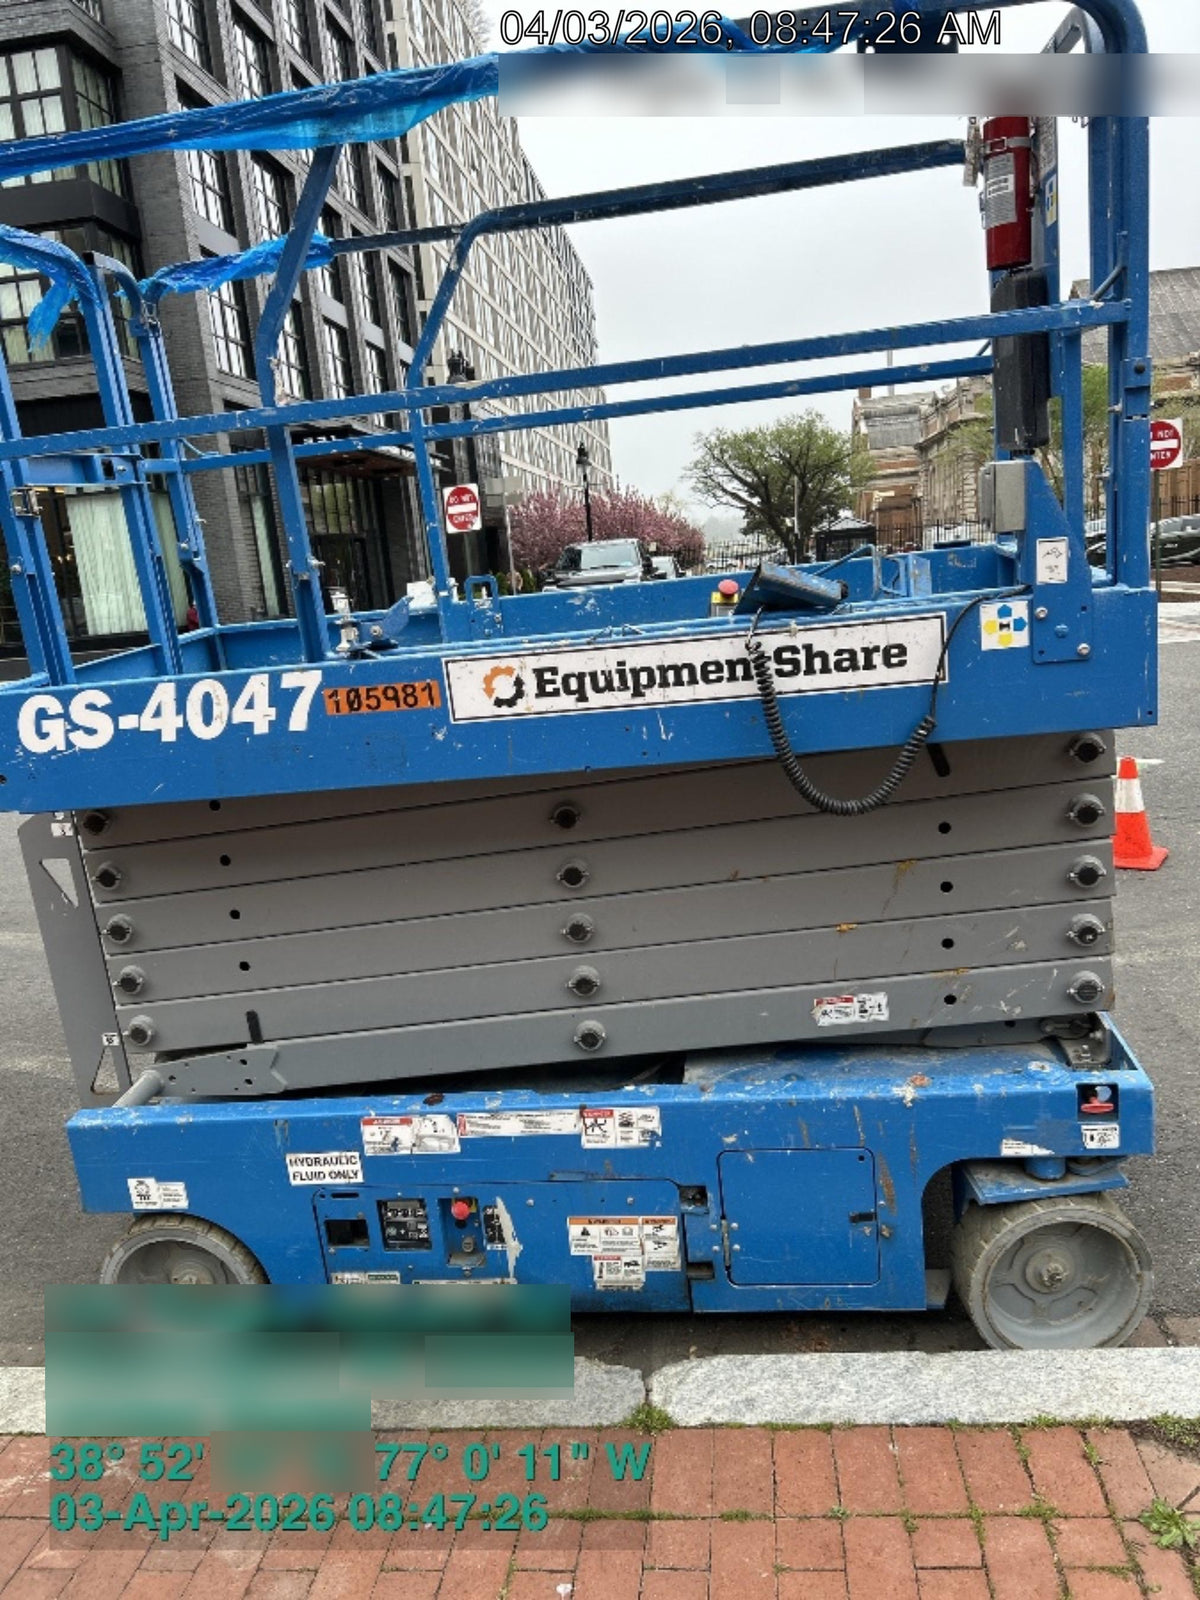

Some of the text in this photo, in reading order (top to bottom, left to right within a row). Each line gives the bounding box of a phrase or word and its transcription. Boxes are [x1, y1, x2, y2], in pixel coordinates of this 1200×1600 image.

[533, 642, 908, 703] EquipmenShare
[17, 669, 323, 755] GS-4047
[327, 682, 435, 714] 105981
[289, 1155, 358, 1167] HYDRAULIC
[292, 1169, 359, 1181] FLUID ONLY
